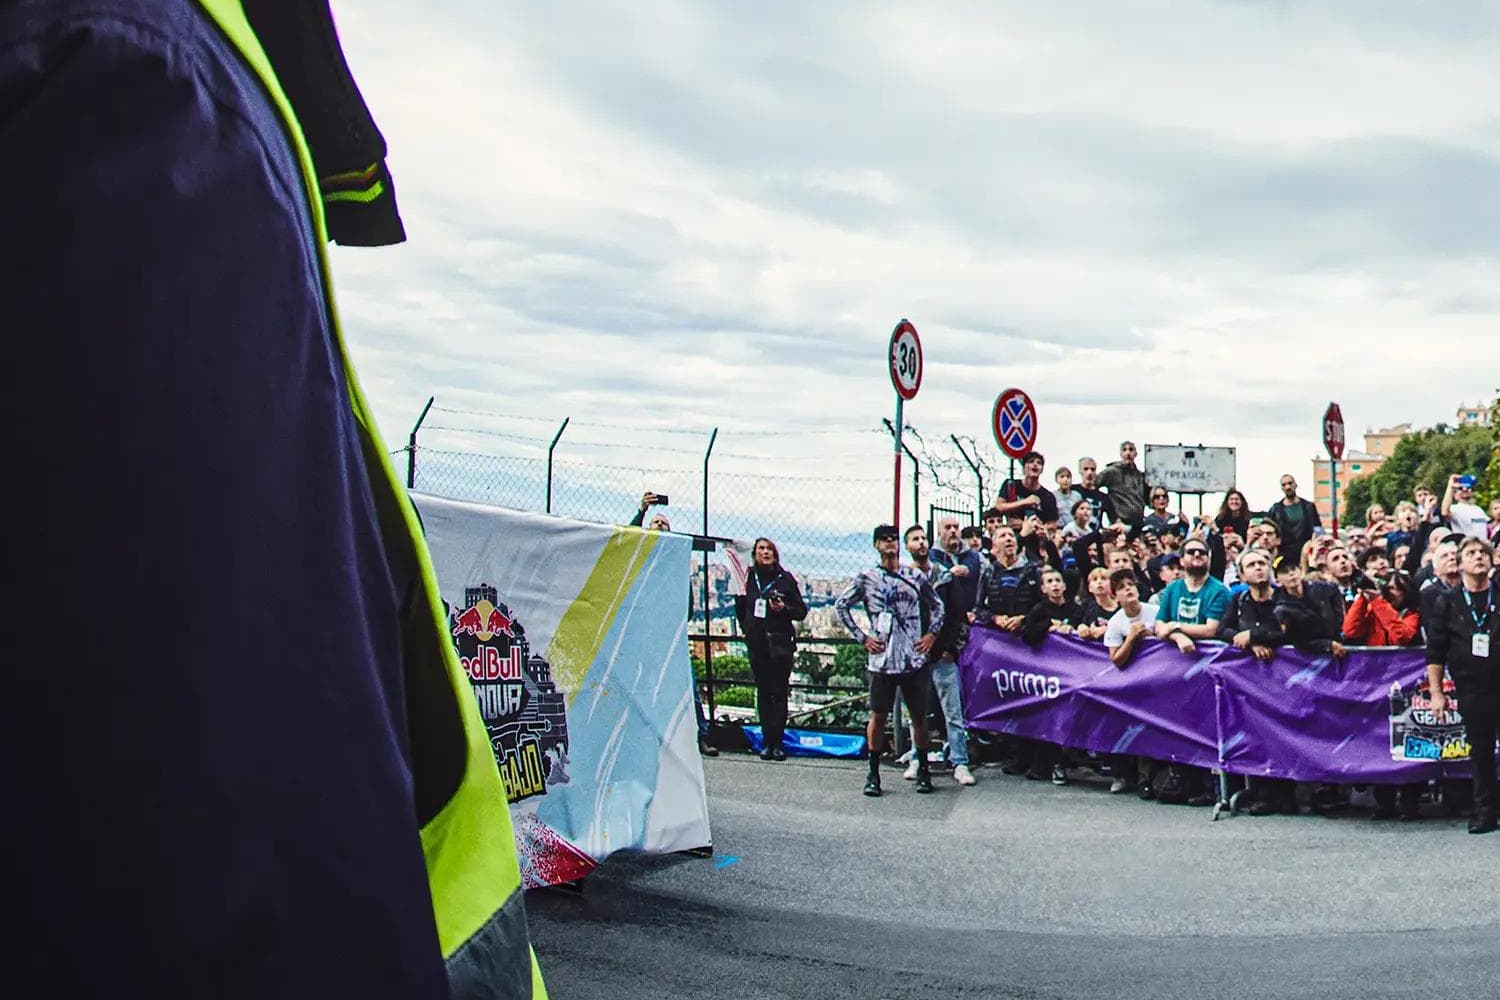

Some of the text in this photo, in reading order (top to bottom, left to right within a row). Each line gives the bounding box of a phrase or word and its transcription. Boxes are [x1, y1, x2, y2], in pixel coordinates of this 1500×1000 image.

[899, 342, 917, 380] 30
[460, 644, 522, 681] ed Bull
[991, 668, 1061, 699] prima
